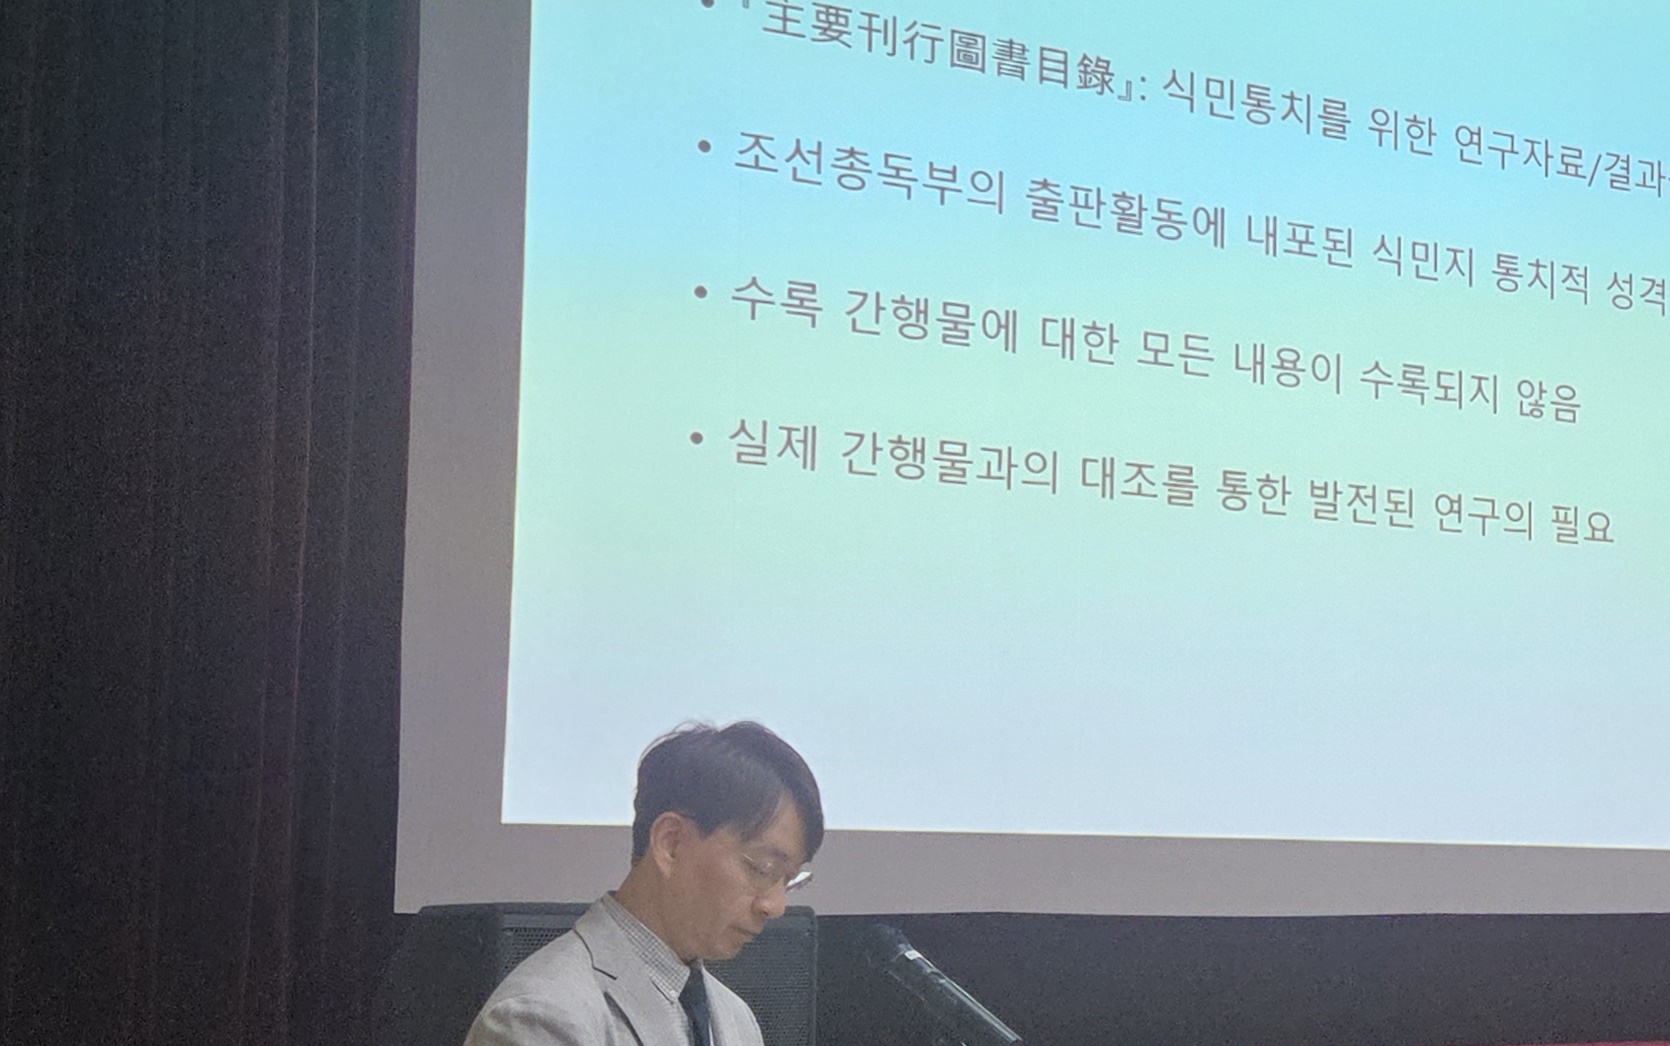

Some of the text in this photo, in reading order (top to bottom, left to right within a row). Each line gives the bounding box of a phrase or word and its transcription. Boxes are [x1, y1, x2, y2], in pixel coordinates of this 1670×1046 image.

[1162, 68, 1352, 141] 식민통치를
[1367, 108, 1438, 157] 위한
[734, 131, 1666, 317] 조선총독부의 출판활동에 내포된 식민지 통치적 성격
[731, 276, 1582, 424] 수록 간행물에 대한 모든 내용이 수록되지 않음
[728, 418, 1615, 545] 실제 간행물과의 대조를 통한 발전된 연구의 필요
